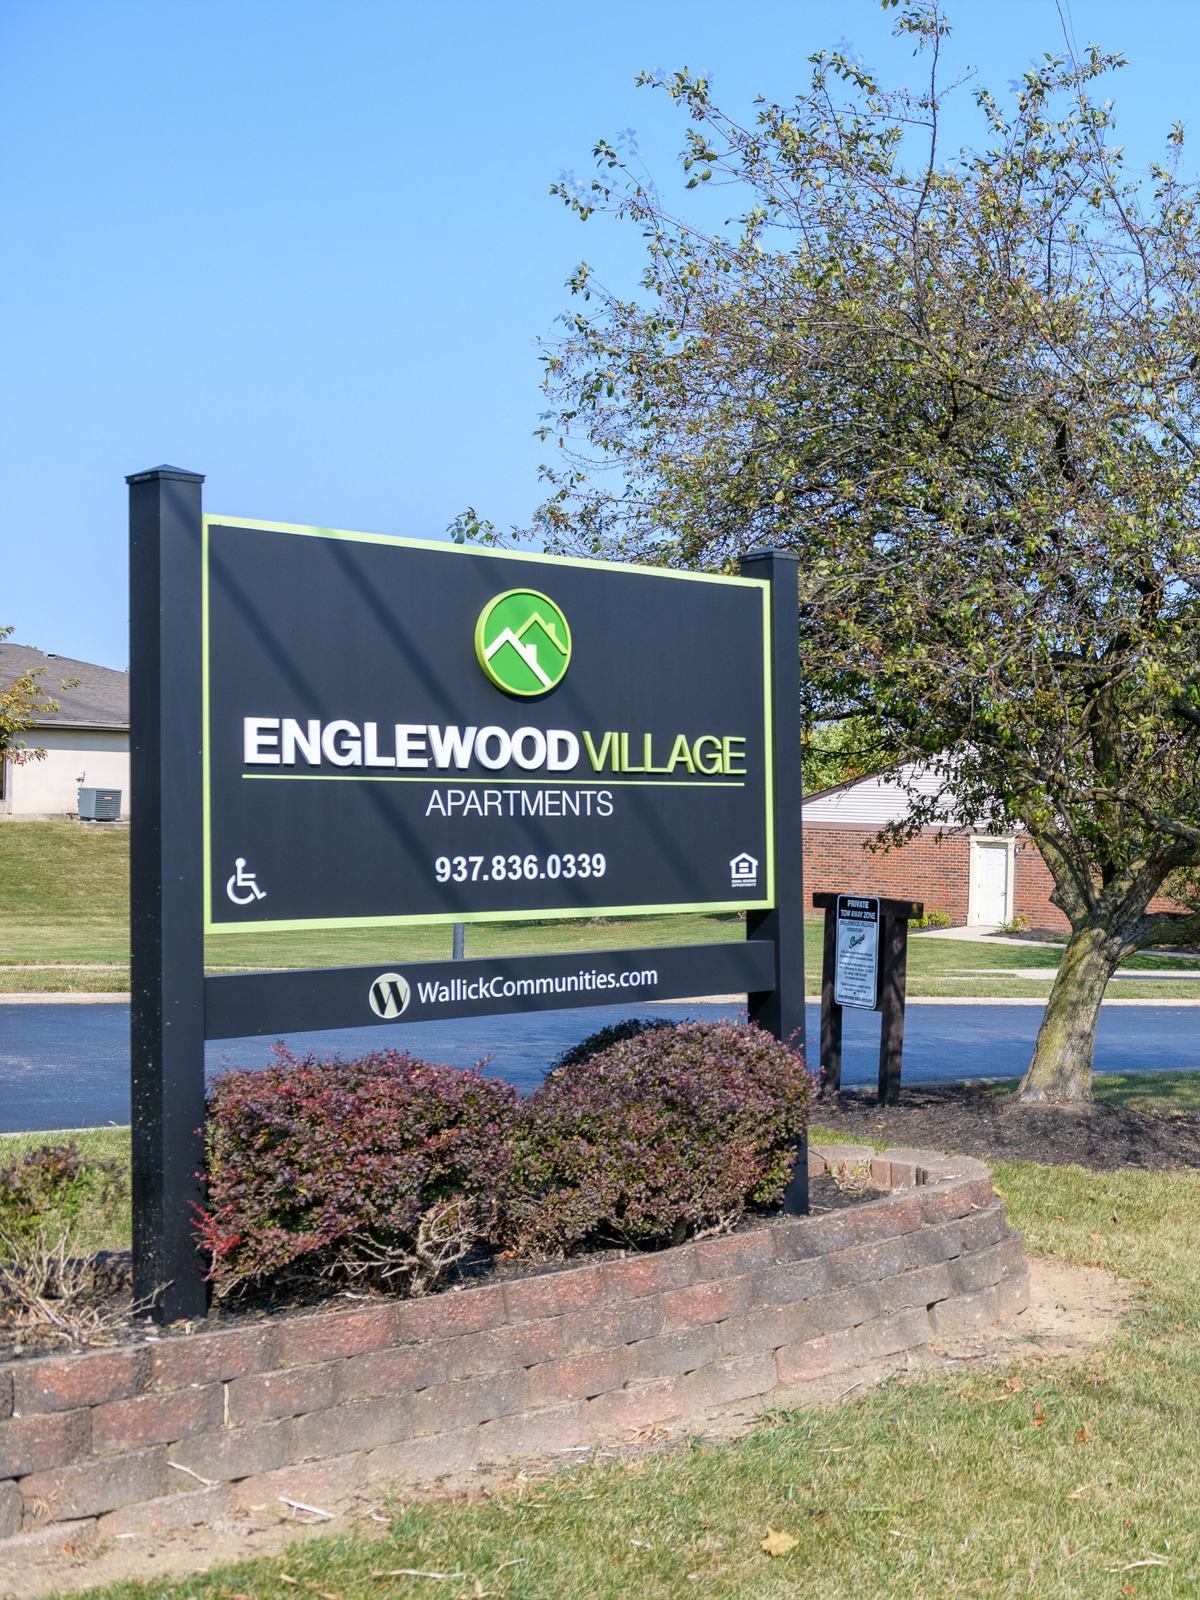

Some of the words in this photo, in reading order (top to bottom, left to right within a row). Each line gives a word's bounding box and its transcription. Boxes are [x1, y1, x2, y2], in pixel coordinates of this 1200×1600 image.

[243, 716, 580, 771] ENGLEWOOD
[582, 730, 747, 775] VILLAGE
[425, 789, 614, 817] APARTMENTS
[434, 853, 607, 882] 937.836.0339
[840, 909, 850, 917] TOW
[863, 911, 876, 920] ZONE
[847, 899, 869, 909] PRIVATE
[417, 969, 658, 1004] WallickCommunities.com
